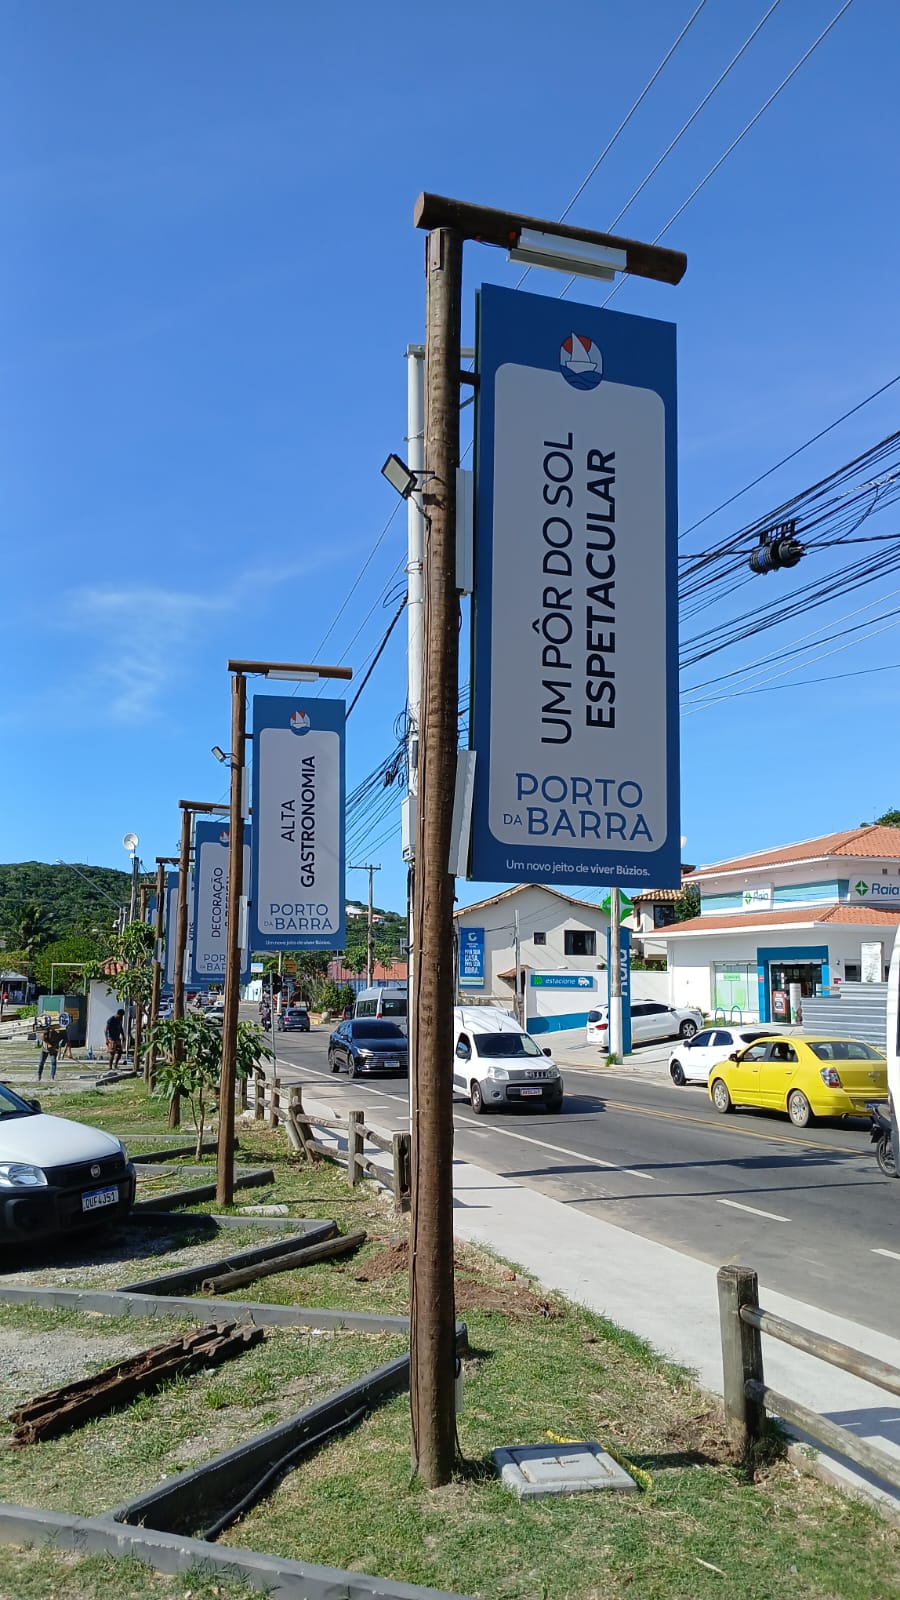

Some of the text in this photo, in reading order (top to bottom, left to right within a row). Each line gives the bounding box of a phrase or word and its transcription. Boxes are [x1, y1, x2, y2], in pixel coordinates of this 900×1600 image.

[532, 432, 573, 744] UM PÔR DO SOL
[586, 449, 615, 728] ESPETACULAR
[516, 773, 642, 808] PORTO
[281, 800, 295, 842] ALTA
[301, 756, 315, 887] GASTRONOMIA
[504, 807, 653, 841] DA BARRA
[505, 859, 650, 877] Um novo jeito de viver Búzios.
[210, 867, 224, 938] DECORAÇÃO
[871, 882, 899, 896] Raia
[270, 904, 328, 916] PORTO
[275, 918, 332, 930] BARRA
[545, 977, 576, 985] estacione
